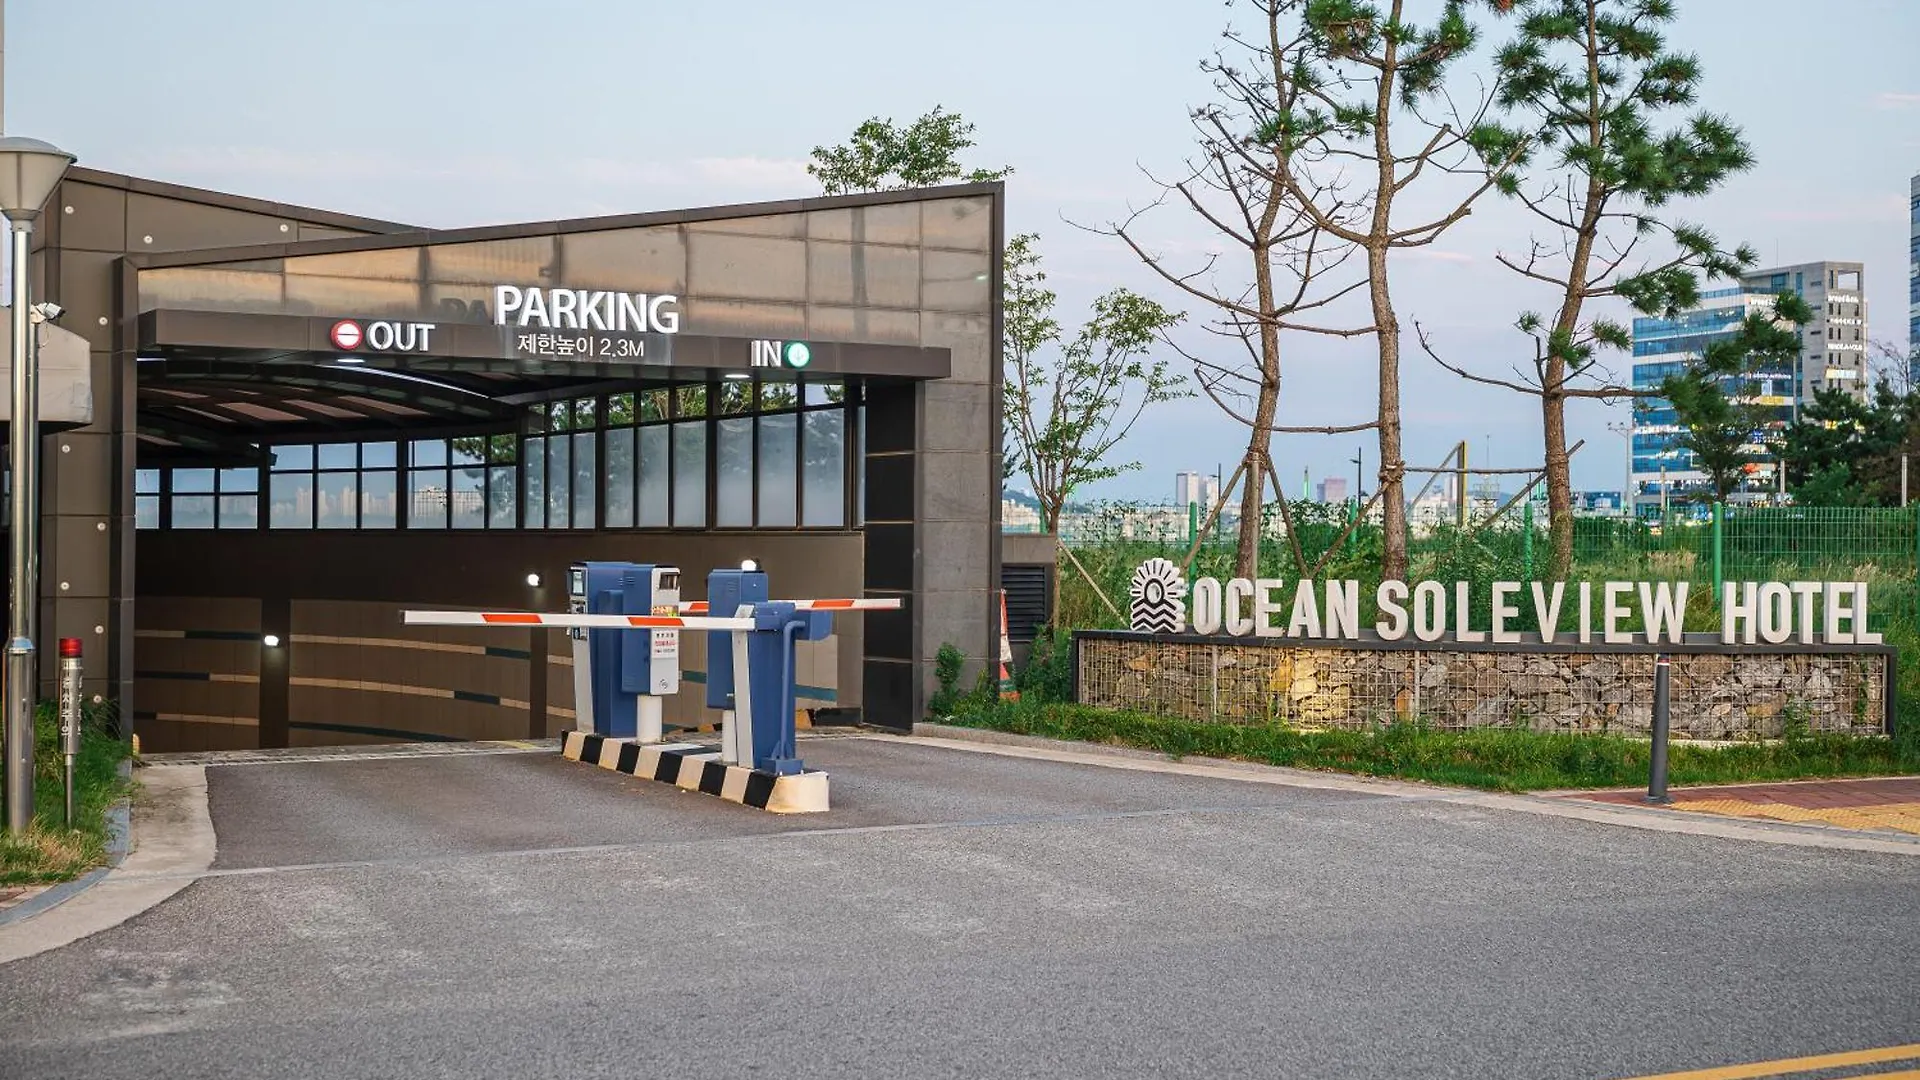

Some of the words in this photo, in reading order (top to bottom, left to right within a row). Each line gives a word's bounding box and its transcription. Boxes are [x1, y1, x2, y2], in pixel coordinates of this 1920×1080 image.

[494, 285, 680, 334] PARKING
[367, 321, 436, 352] OUT
[517, 333, 594, 357] 제한높이
[600, 338, 645, 358] 2.3M
[751, 340, 782, 367] IN
[1193, 577, 1359, 640] OCEAN
[1721, 581, 1883, 645] HOTEL
